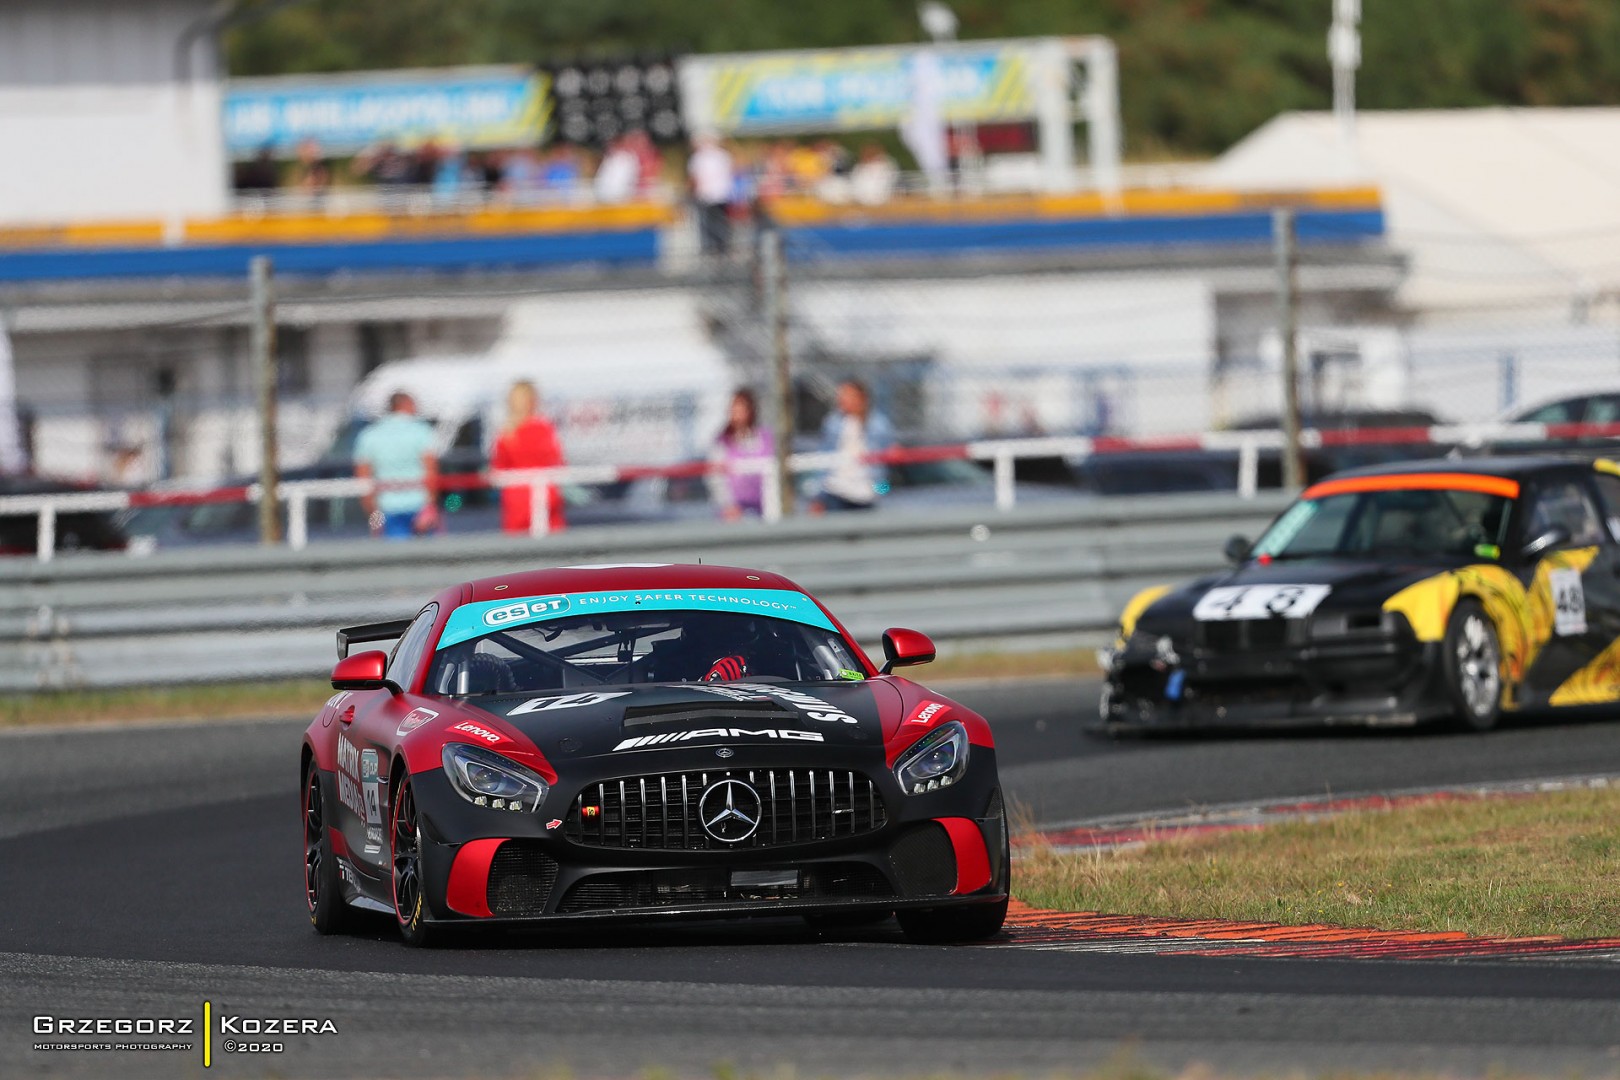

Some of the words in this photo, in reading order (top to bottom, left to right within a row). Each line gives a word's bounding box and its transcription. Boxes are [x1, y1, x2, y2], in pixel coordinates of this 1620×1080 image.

[579, 595, 628, 605] ENJOY
[531, 693, 600, 711] 14
[911, 703, 945, 723] Lenovo
[454, 722, 500, 743] Lenovo
[680, 728, 825, 742] AMG
